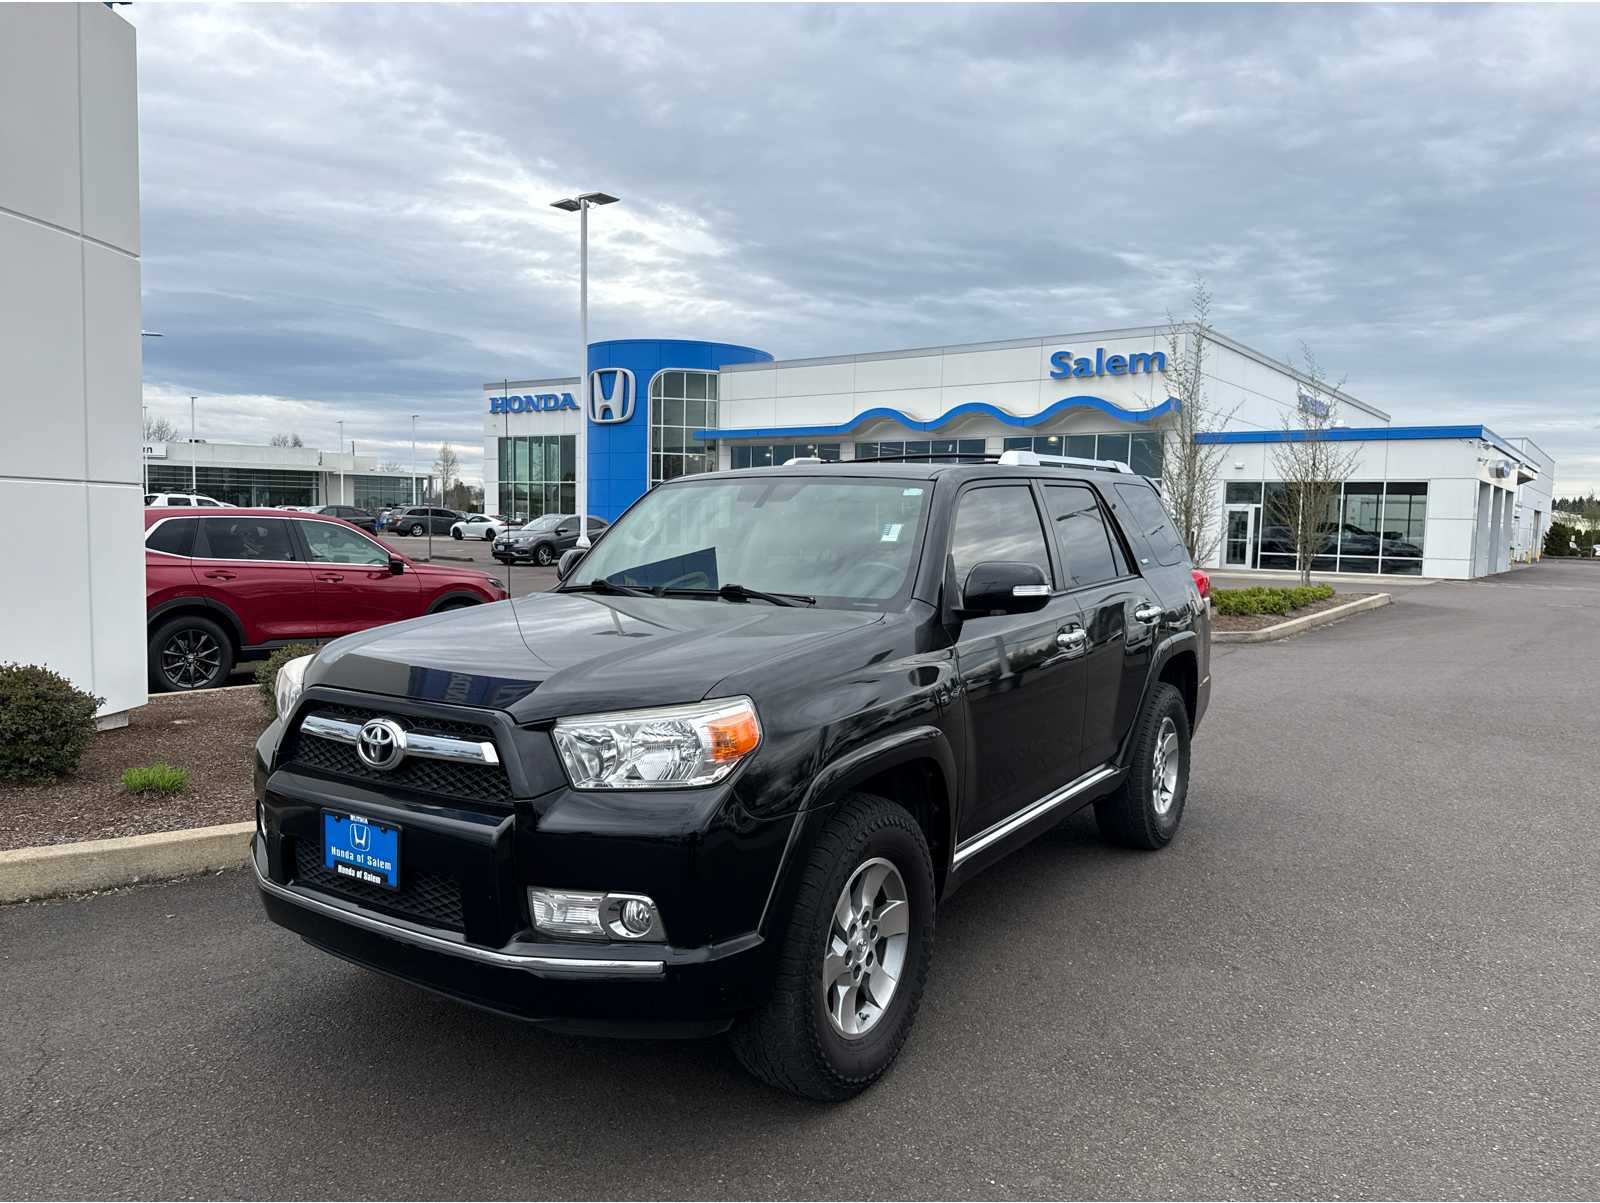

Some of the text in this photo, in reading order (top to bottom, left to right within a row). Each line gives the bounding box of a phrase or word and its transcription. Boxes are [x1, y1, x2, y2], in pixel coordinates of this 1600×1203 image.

[1049, 347, 1166, 380] Salem
[488, 392, 580, 414] HONDA
[331, 845, 392, 871] Honda of Salem
[337, 864, 356, 877] Honda
[363, 871, 382, 884] Salem
